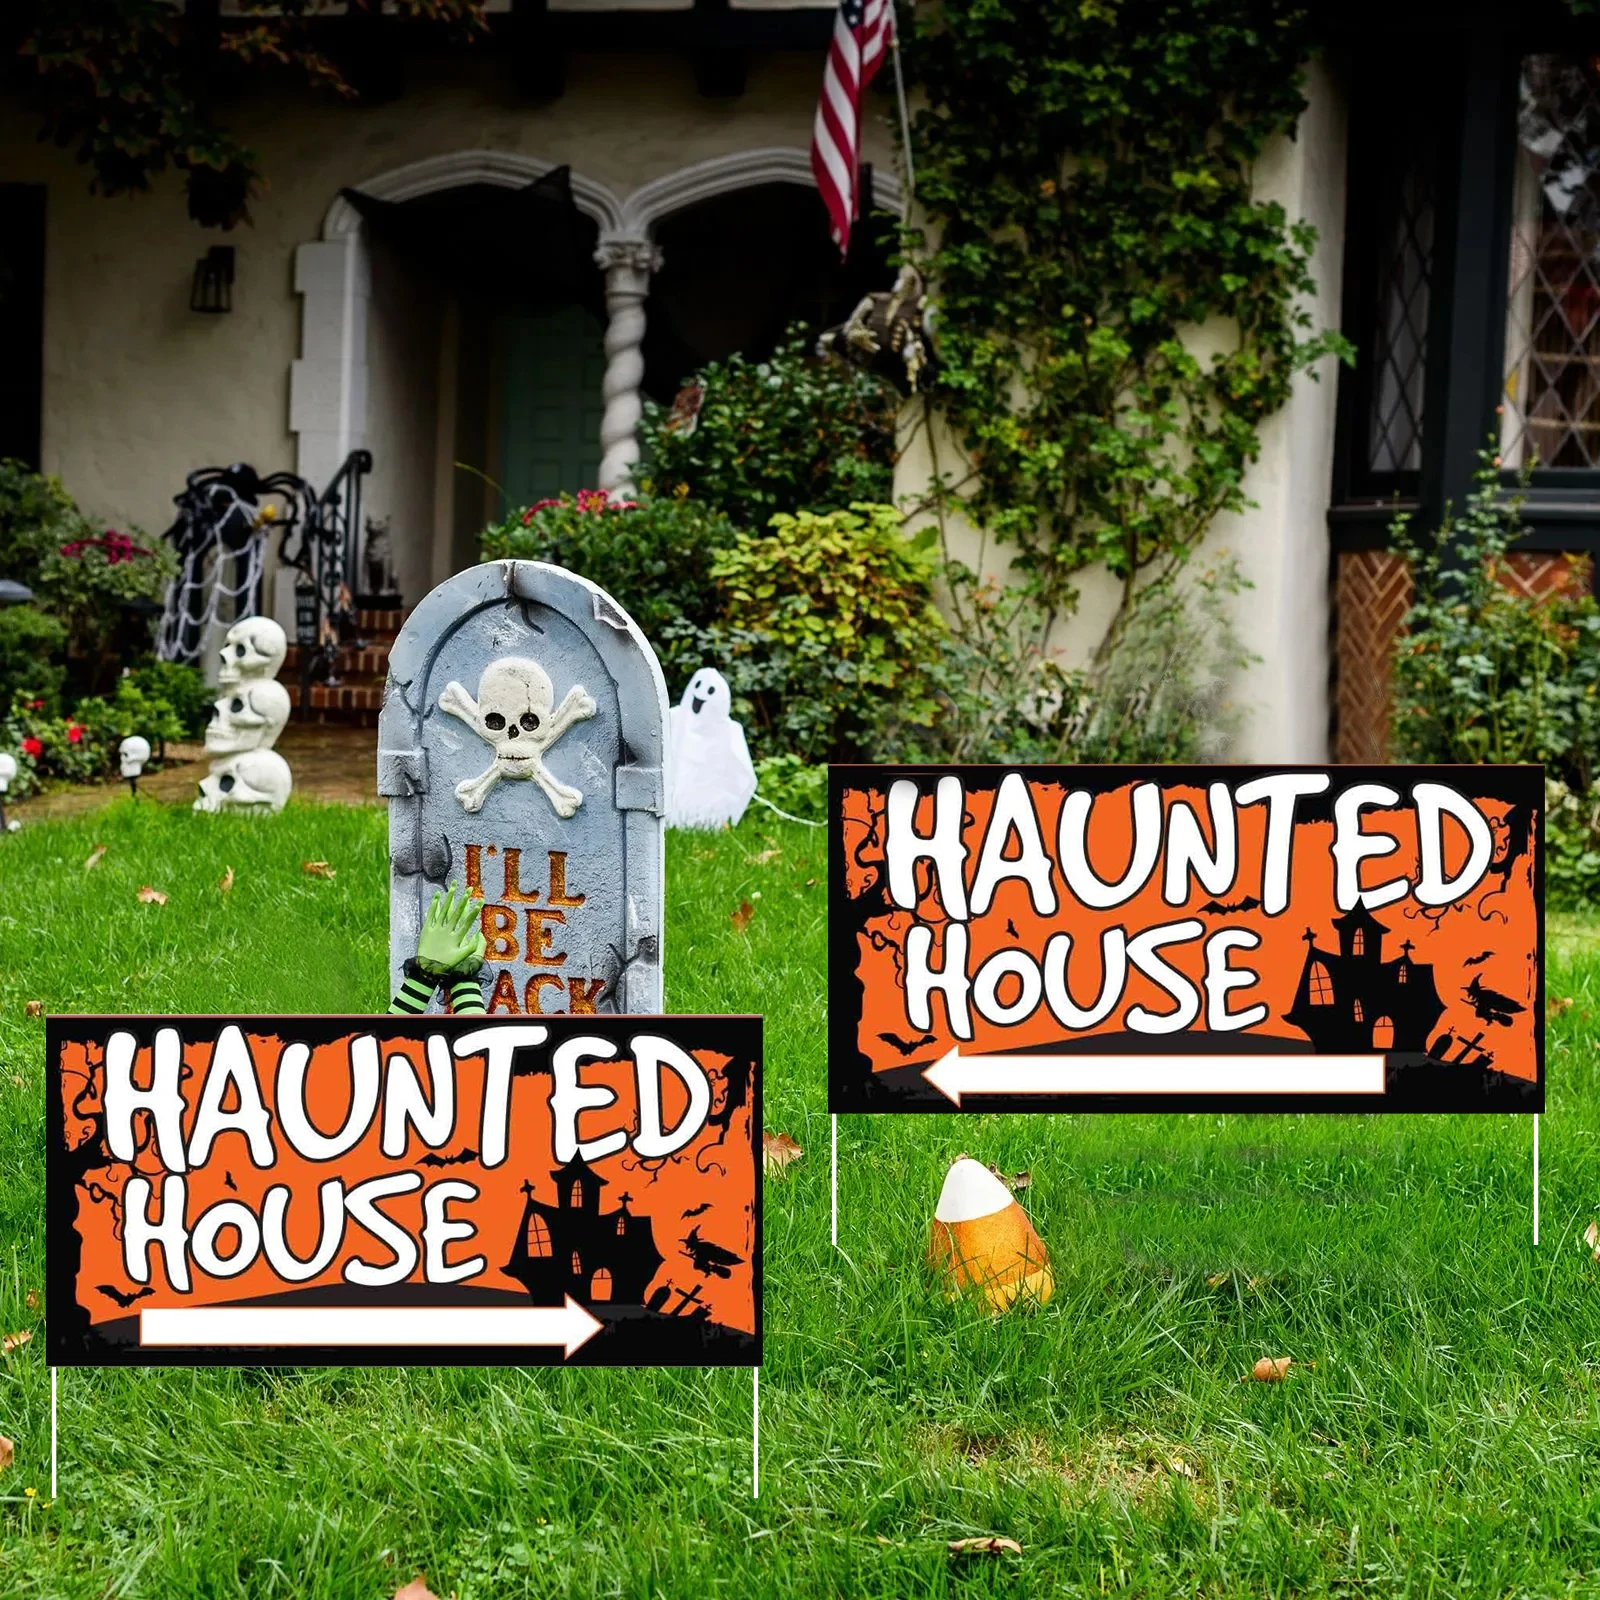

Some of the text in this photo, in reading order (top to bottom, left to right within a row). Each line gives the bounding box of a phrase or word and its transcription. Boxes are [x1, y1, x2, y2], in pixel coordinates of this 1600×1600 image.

[464, 843, 587, 907] I'LL
[885, 771, 1493, 922] HAUNTED
[443, 969, 607, 1014] ACK
[480, 904, 567, 967] BE
[904, 919, 1267, 1040] HOUSE
[103, 1024, 711, 1173] HAUNTED
[122, 1173, 485, 1291] HOUSE
